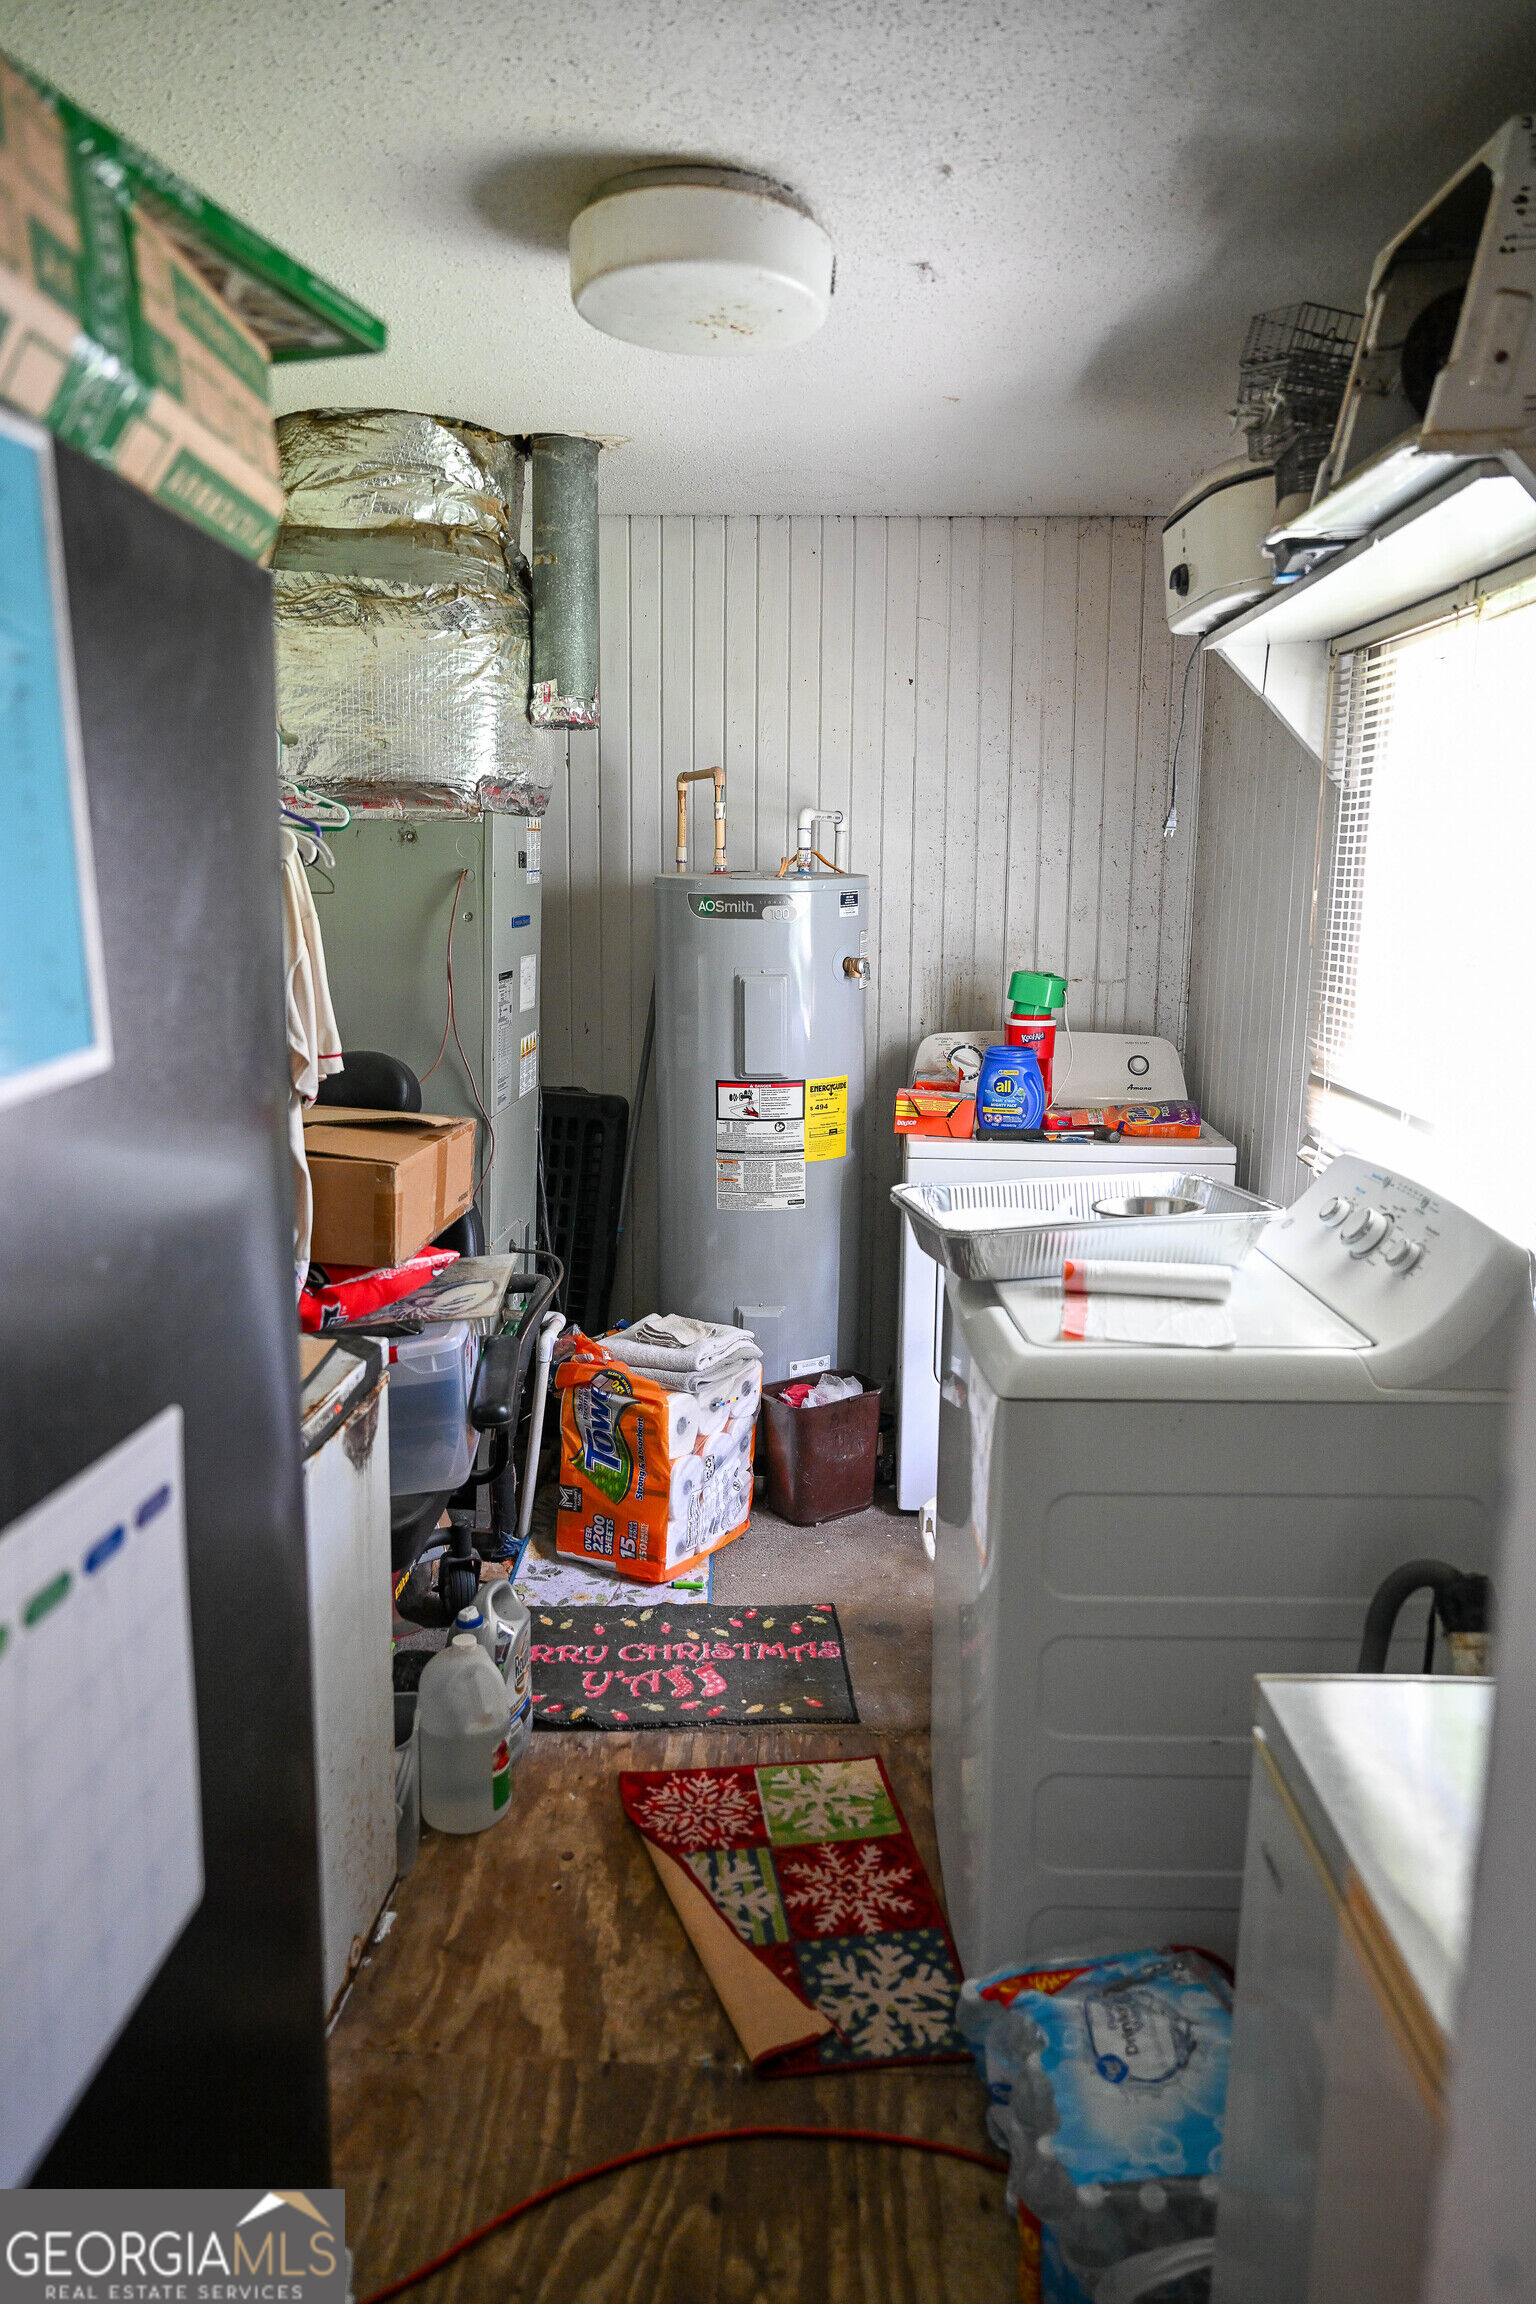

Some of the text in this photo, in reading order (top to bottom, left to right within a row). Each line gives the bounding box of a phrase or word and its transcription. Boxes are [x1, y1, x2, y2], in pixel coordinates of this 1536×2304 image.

[995, 1080, 1012, 1093] all
[1126, 1083, 1153, 1091] Amana
[815, 1103, 829, 1111] 494
[896, 1119, 918, 1127] bounce
[636, 1416, 645, 1462] Absorbent
[635, 1470, 648, 1501] Strong
[584, 1526, 593, 1551] OVER
[592, 1514, 605, 1554] 2200
[604, 1518, 615, 1556] SHEETS
[620, 1536, 637, 1559] 15
[639, 1541, 648, 1561] 150
[531, 1641, 843, 1664] RRY CHRISTMAS
